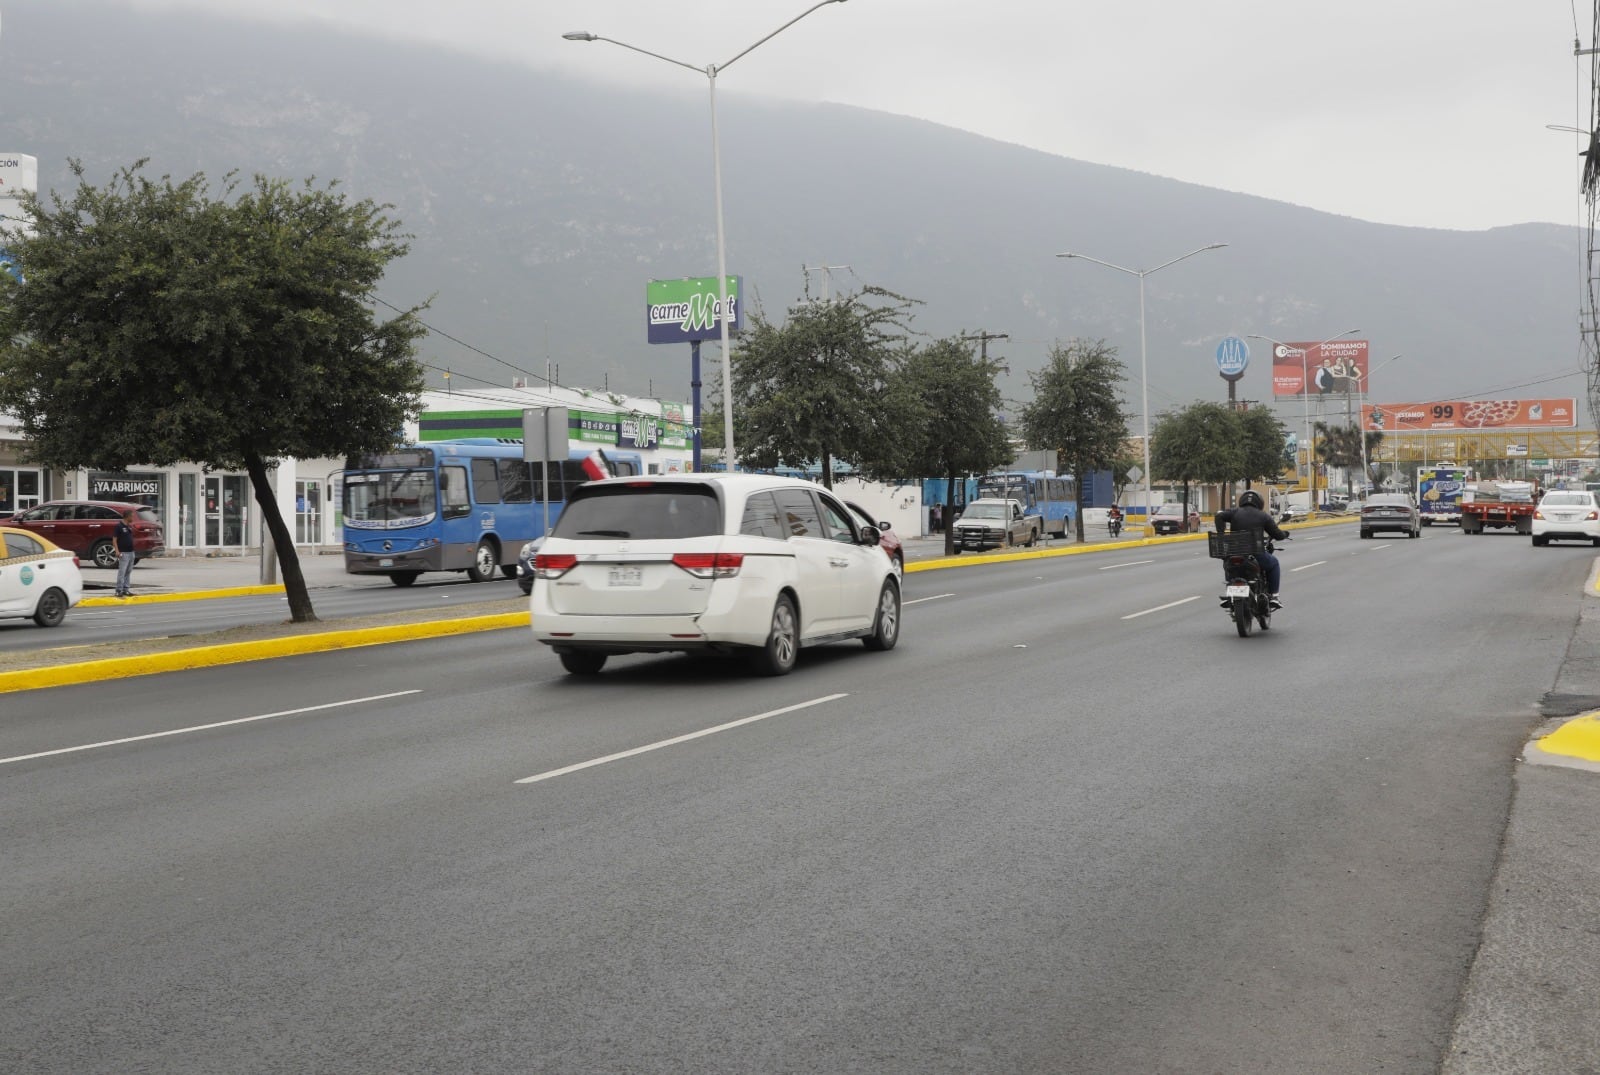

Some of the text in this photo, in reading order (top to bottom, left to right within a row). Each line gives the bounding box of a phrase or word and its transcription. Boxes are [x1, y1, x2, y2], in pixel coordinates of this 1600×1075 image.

[1320, 342, 1367, 350] DOMINAMOS
[94, 481, 158, 494] ¡YA ABRIMOS!
